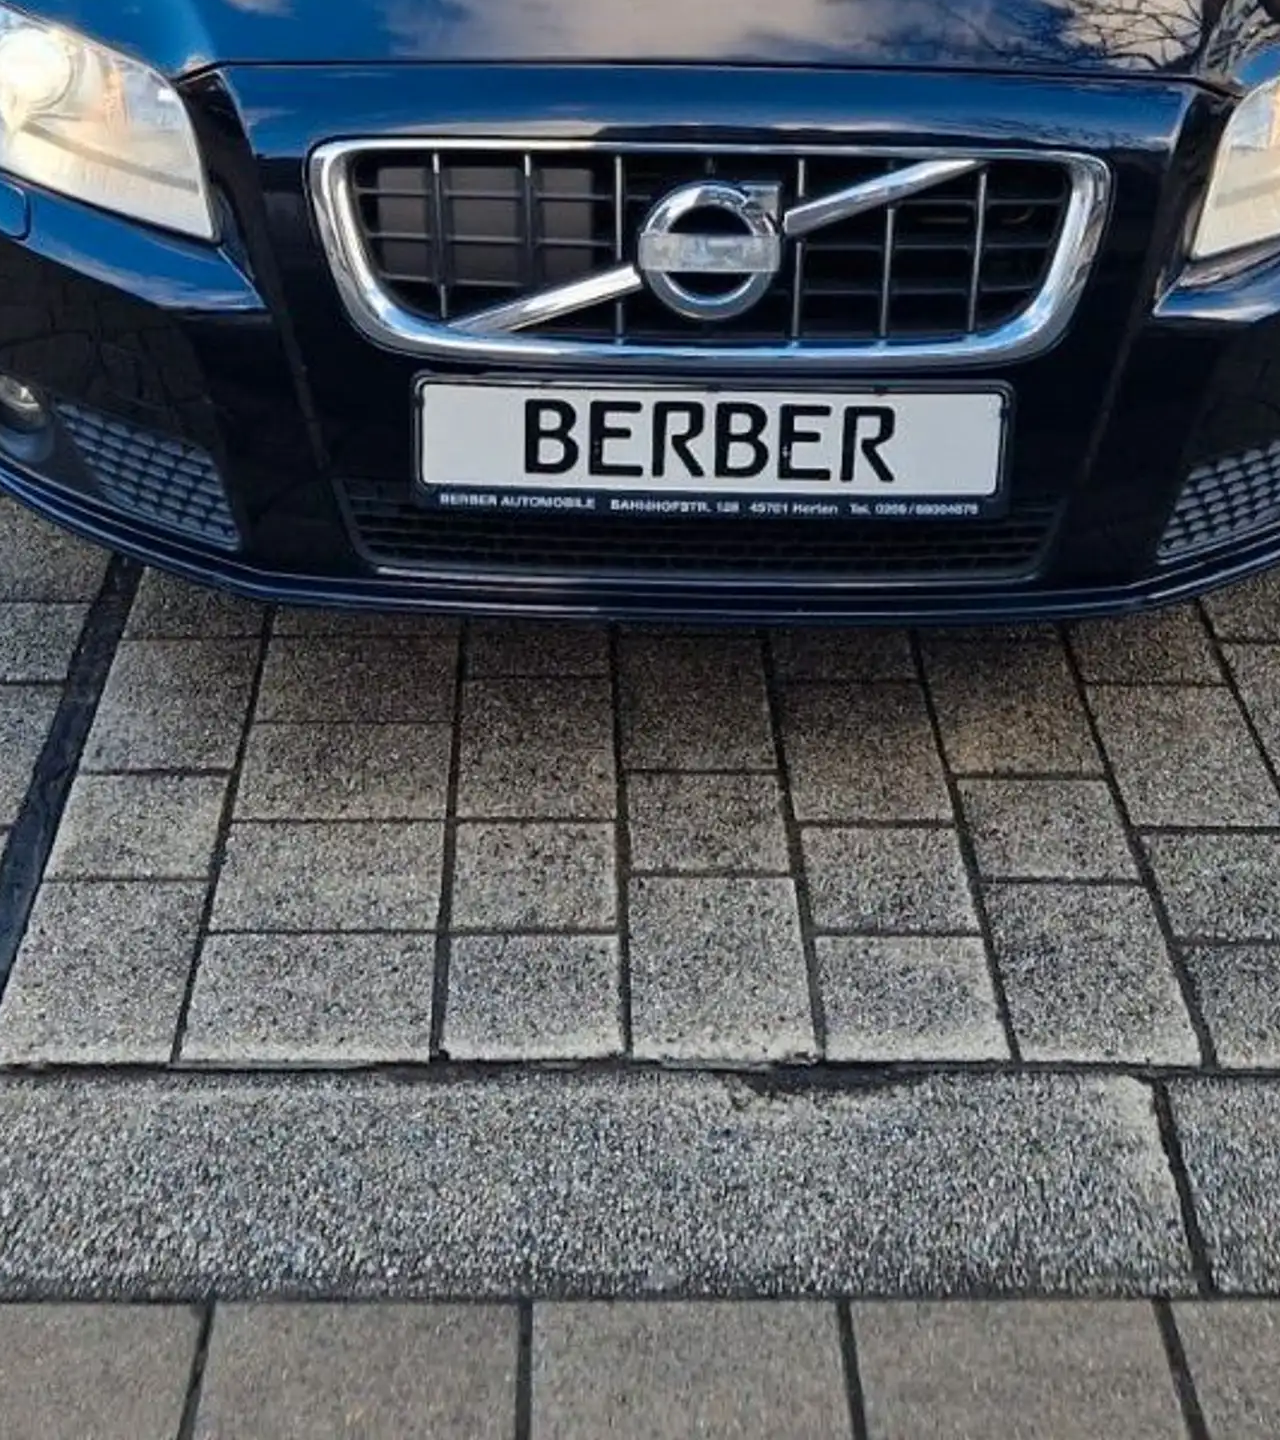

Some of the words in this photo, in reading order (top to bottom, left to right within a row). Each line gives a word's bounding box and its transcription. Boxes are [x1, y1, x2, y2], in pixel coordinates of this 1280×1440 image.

[523, 398, 895, 483] BERBER
[439, 493, 497, 506] BERBER
[501, 494, 596, 510] AUTOMOBILE
